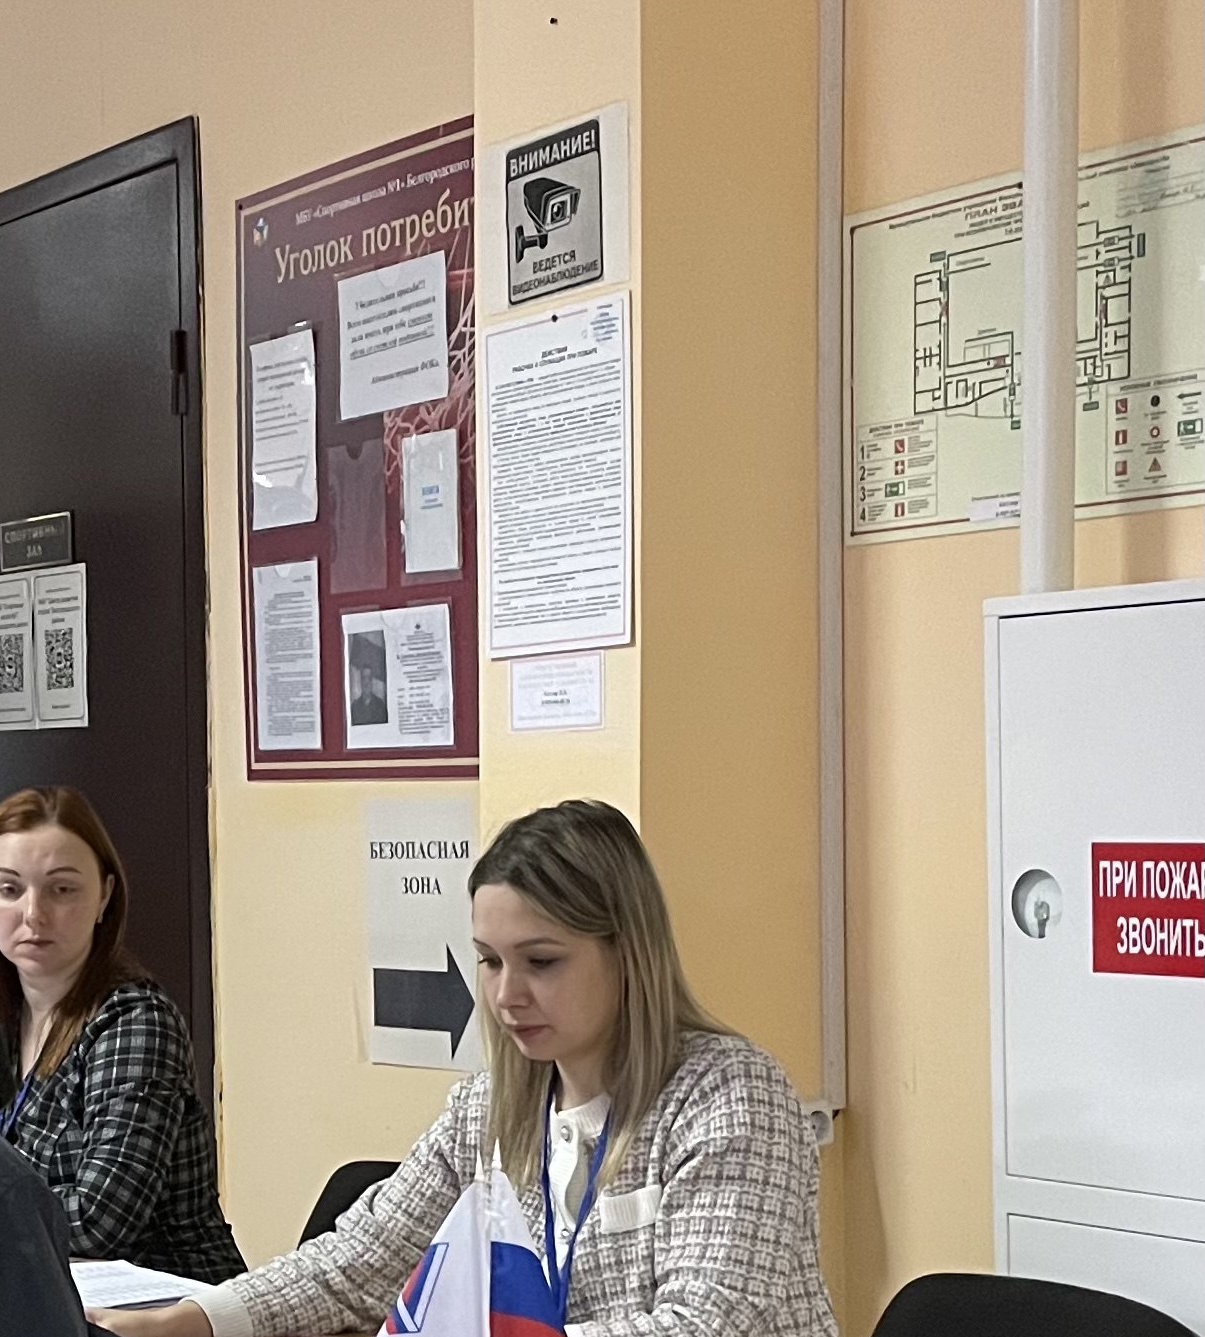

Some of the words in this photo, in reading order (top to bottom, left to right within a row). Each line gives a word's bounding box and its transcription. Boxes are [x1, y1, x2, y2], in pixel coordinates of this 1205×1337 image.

[509, 129, 596, 178] ВНИМАНИЕ!
[274, 233, 354, 284] Уголок
[532, 250, 577, 274] ВЕДЕТСЯ
[512, 259, 600, 296] ВИДЕОНАБЛЮДЕНИЕ
[369, 840, 470, 860] БЕЗОПАСНАЯ
[400, 876, 443, 895] ЗОНА
[1098, 860, 1138, 898] ПРИ
[1116, 916, 1204, 958] ЗВОНИТЬ
